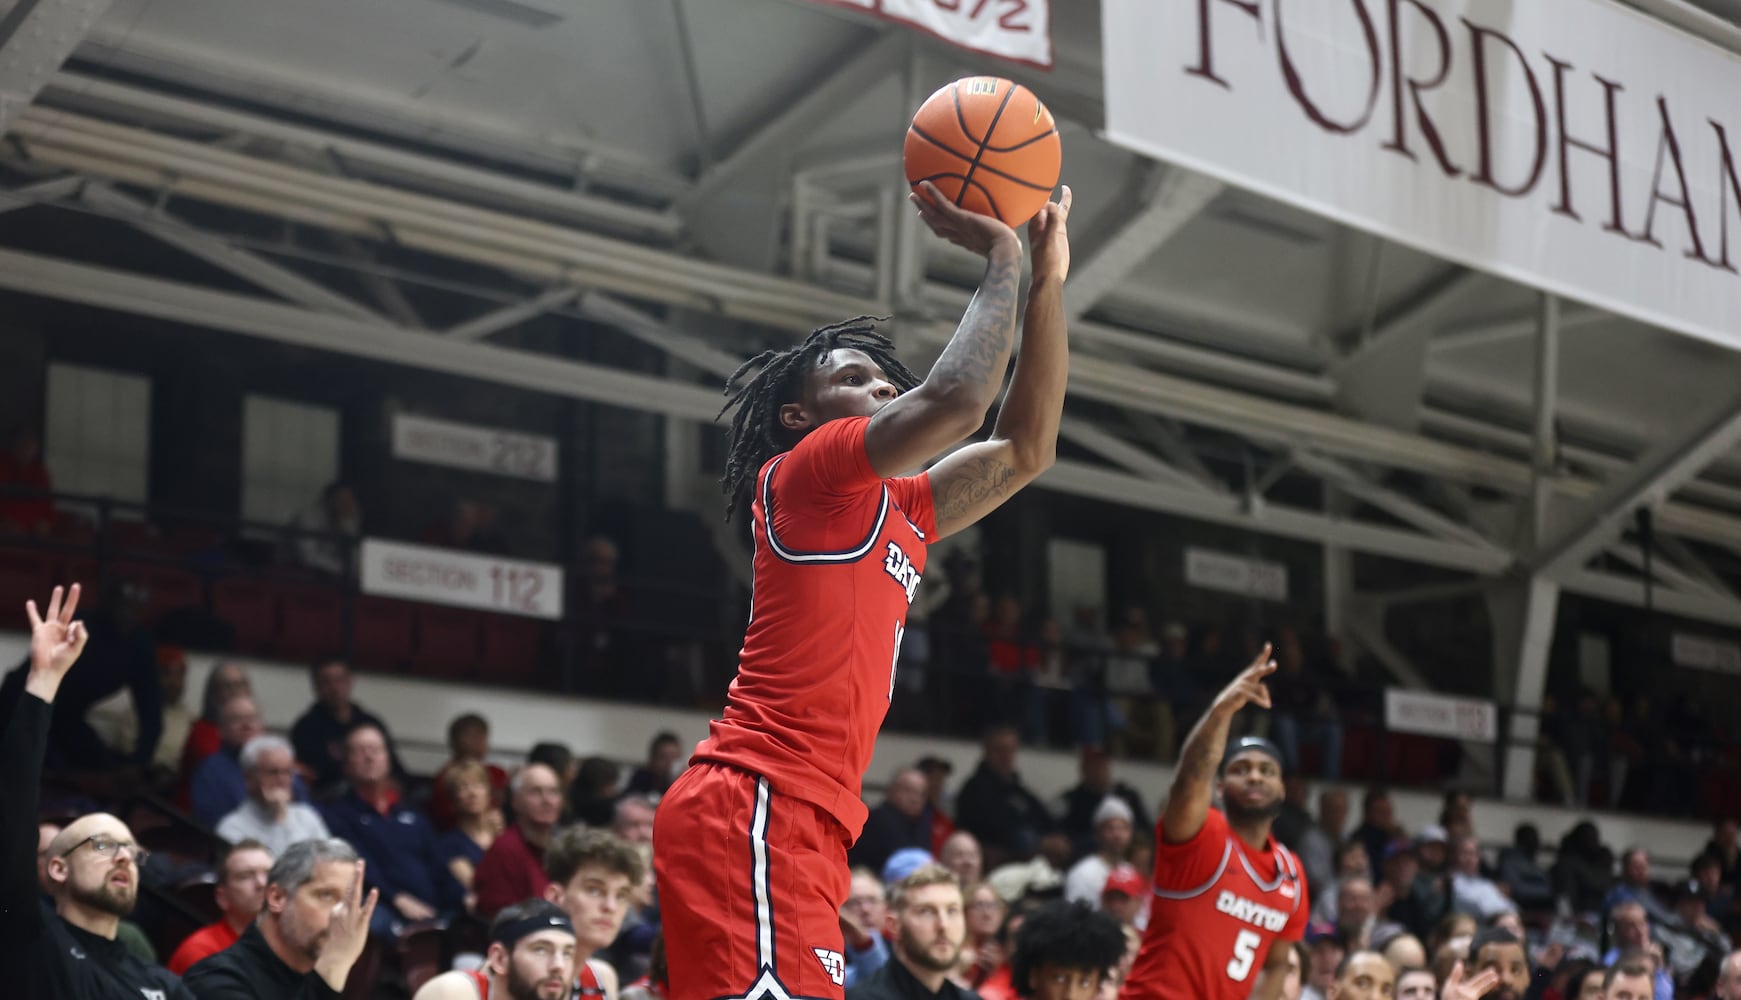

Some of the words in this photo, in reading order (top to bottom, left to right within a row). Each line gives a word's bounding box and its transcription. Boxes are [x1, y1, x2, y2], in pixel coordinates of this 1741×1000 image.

[383, 556, 478, 592] SECTION
[489, 564, 545, 612] 112
[1216, 889, 1290, 933] DAYTON
[1226, 928, 1262, 983] 5
